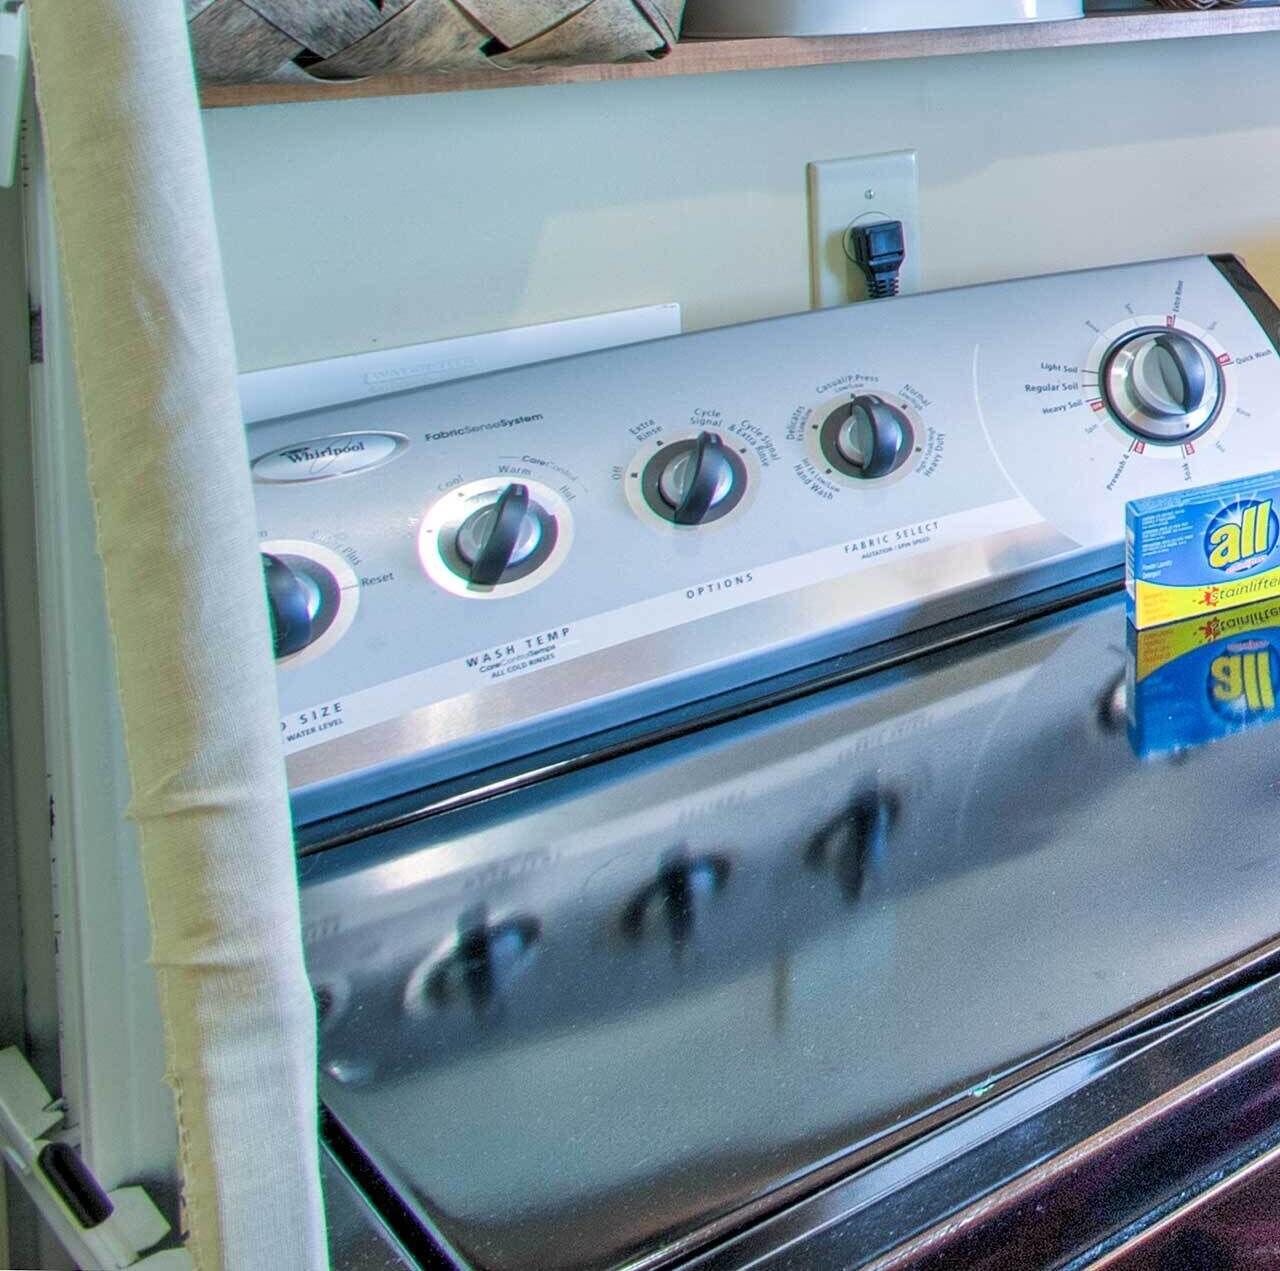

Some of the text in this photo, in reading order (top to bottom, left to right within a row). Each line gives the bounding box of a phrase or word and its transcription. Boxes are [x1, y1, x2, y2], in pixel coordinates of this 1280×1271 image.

[1040, 361, 1079, 374] Light Soil
[1235, 355, 1254, 365] Quick
[856, 373, 879, 383] Press
[1024, 381, 1079, 394] Regular Soil
[903, 383, 932, 407] Normal
[1041, 399, 1084, 415] Heavy Soil
[690, 416, 723, 428] Signal
[693, 407, 721, 418] Cycle
[785, 404, 806, 441] Delicates
[424, 412, 544, 442] FabricSenseSystem
[628, 418, 656, 436] Extra
[637, 425, 664, 442] Rinse
[735, 428, 757, 446] Extra
[754, 444, 770, 468] Rinse
[741, 419, 781, 462] Cycle Signal
[279, 441, 366, 465] Whirlpool
[497, 464, 532, 477] Warm
[792, 463, 834, 501] Hand Wash
[1105, 460, 1127, 492] Prewash
[844, 521, 939, 554] FABRIC SELECT
[1208, 498, 1274, 569] all
[360, 571, 396, 587] Reset
[686, 572, 753, 600] OPTIONS
[465, 627, 570, 668] WASH TEMP
[491, 652, 556, 679] ALL COLD RINSES
[299, 701, 343, 725] SIZE
[286, 726, 317, 743] WATER
[318, 717, 344, 732] LEVEL
